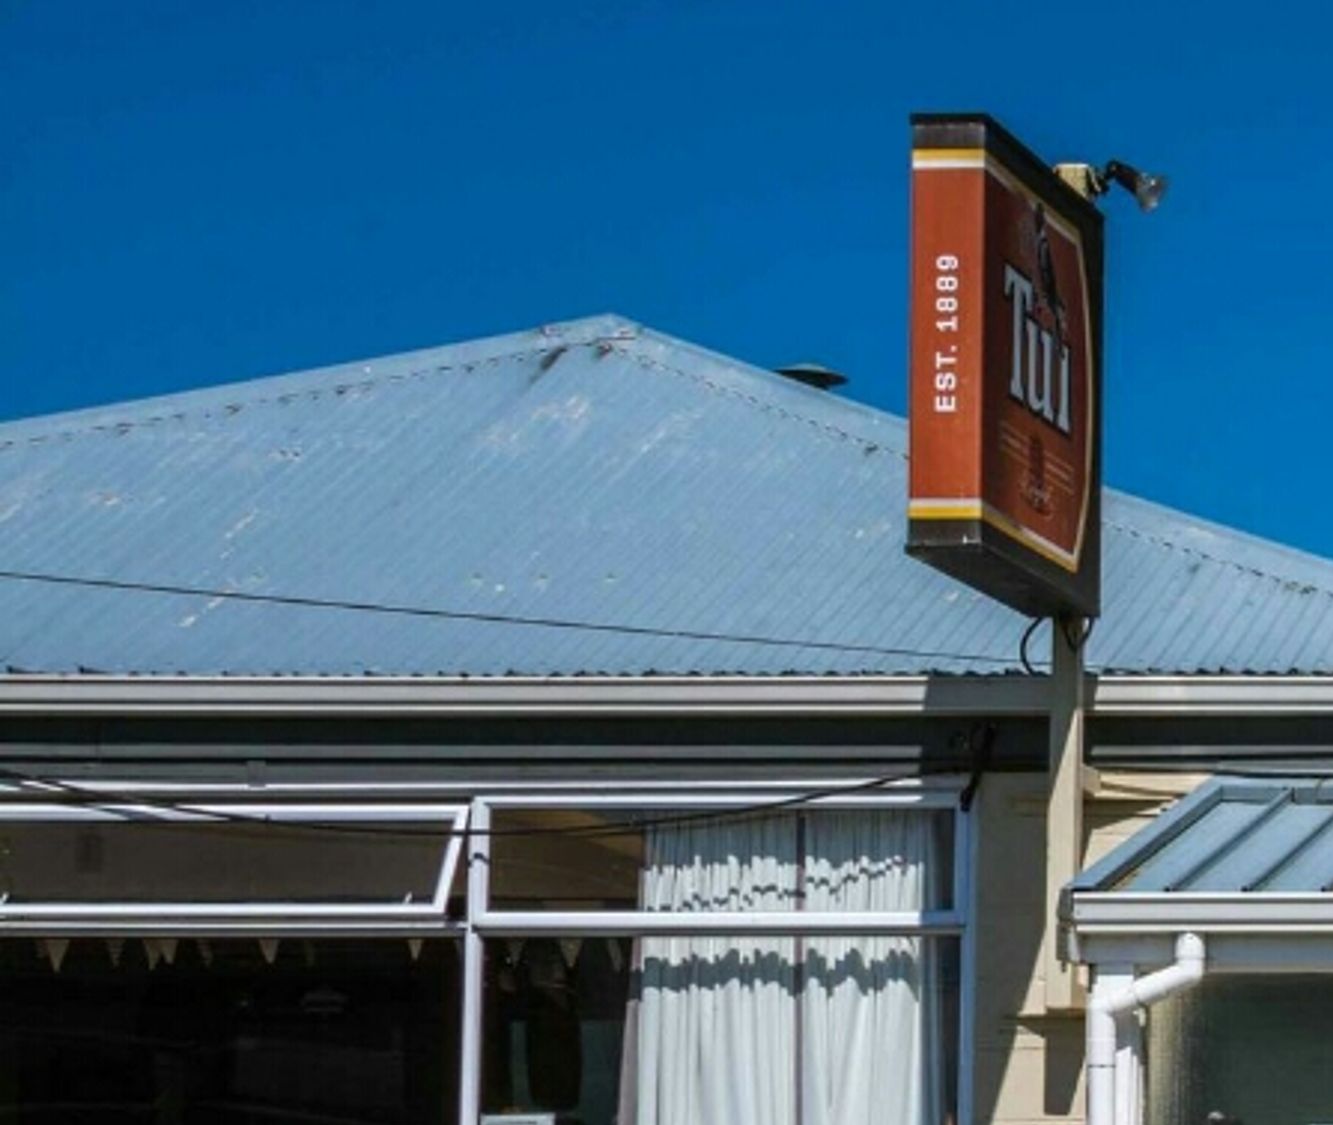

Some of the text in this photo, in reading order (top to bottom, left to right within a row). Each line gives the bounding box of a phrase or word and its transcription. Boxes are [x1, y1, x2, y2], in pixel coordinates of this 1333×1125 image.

[935, 253, 959, 413] EST. 1889
[1003, 264, 1072, 435] Tui
